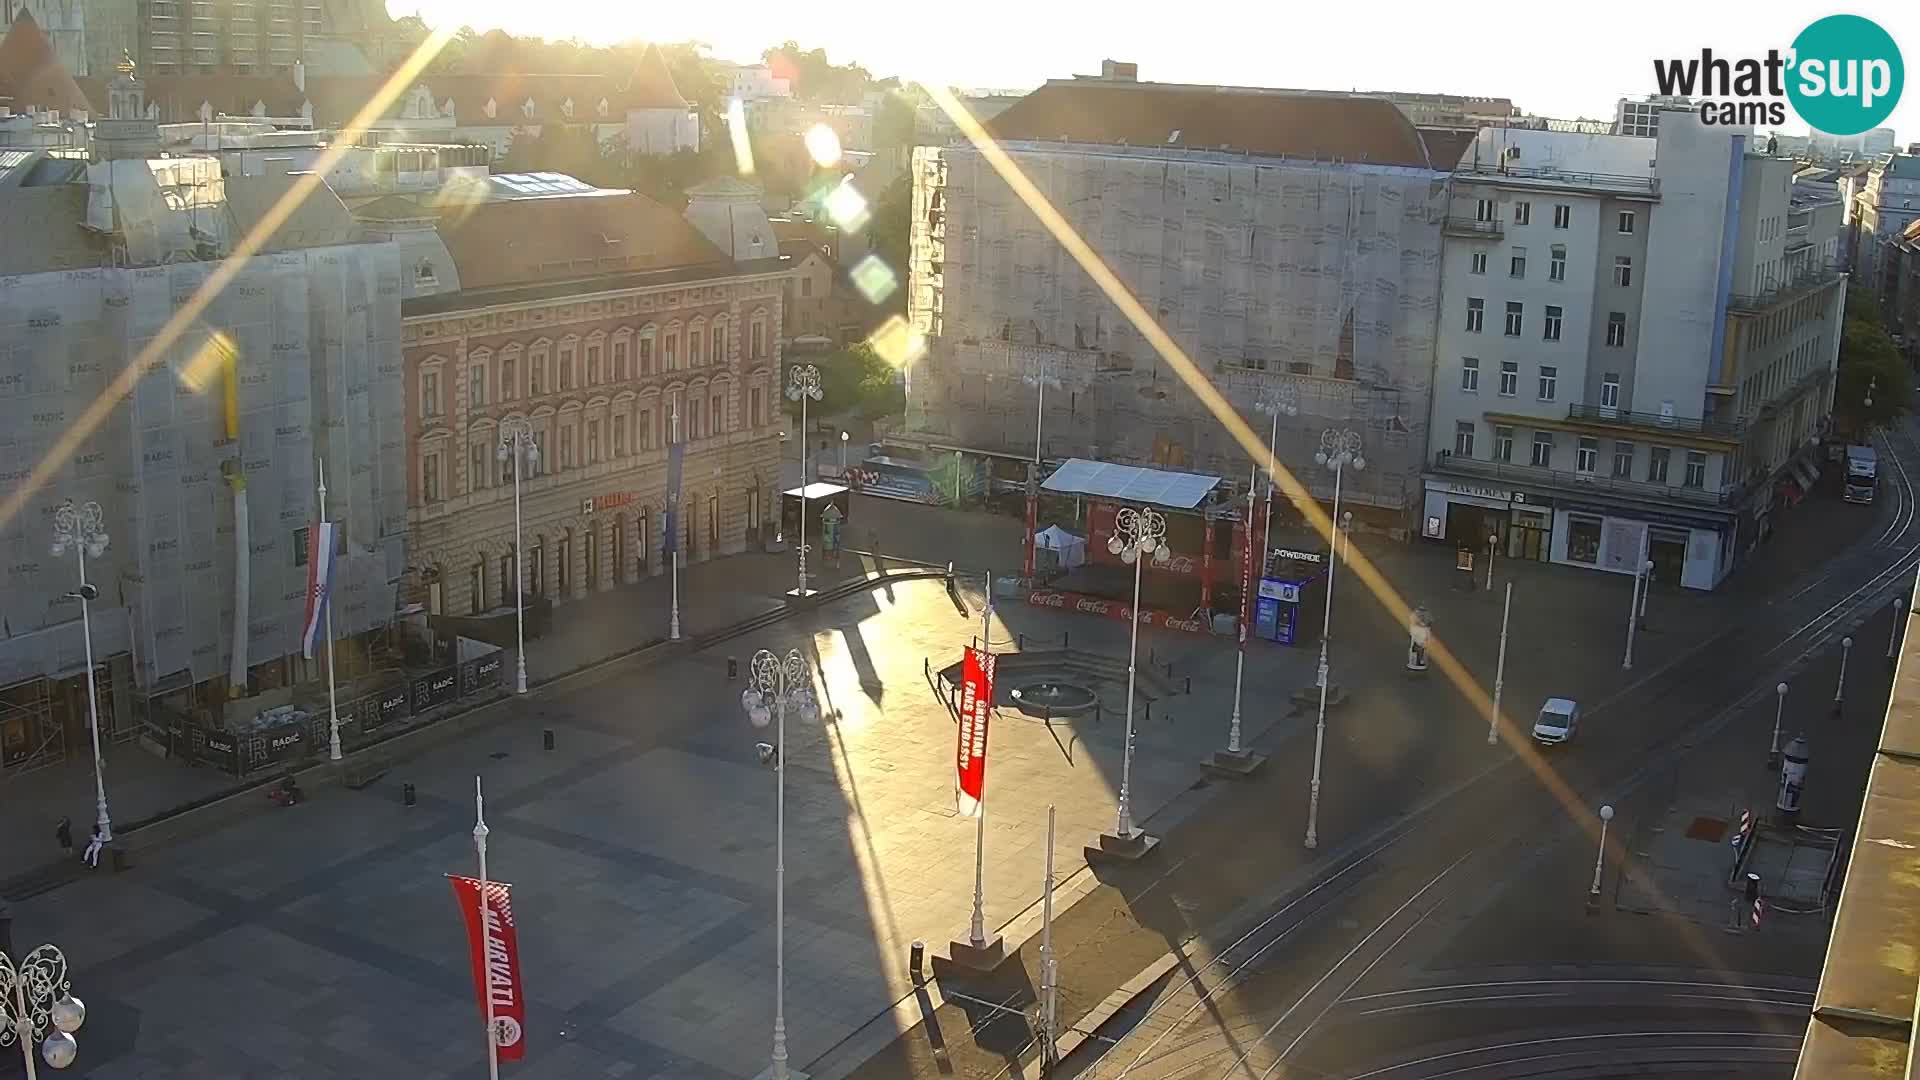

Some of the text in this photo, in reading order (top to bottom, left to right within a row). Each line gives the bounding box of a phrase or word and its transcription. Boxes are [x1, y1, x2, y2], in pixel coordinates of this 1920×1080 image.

[1030, 591, 1065, 608] Coca-Cola
[1077, 598, 1110, 615] Coca-Cola
[960, 681, 976, 770] FANS EMBASSY
[972, 699, 987, 758] CROATIAN
[487, 909, 514, 1008] MI HRVATI
